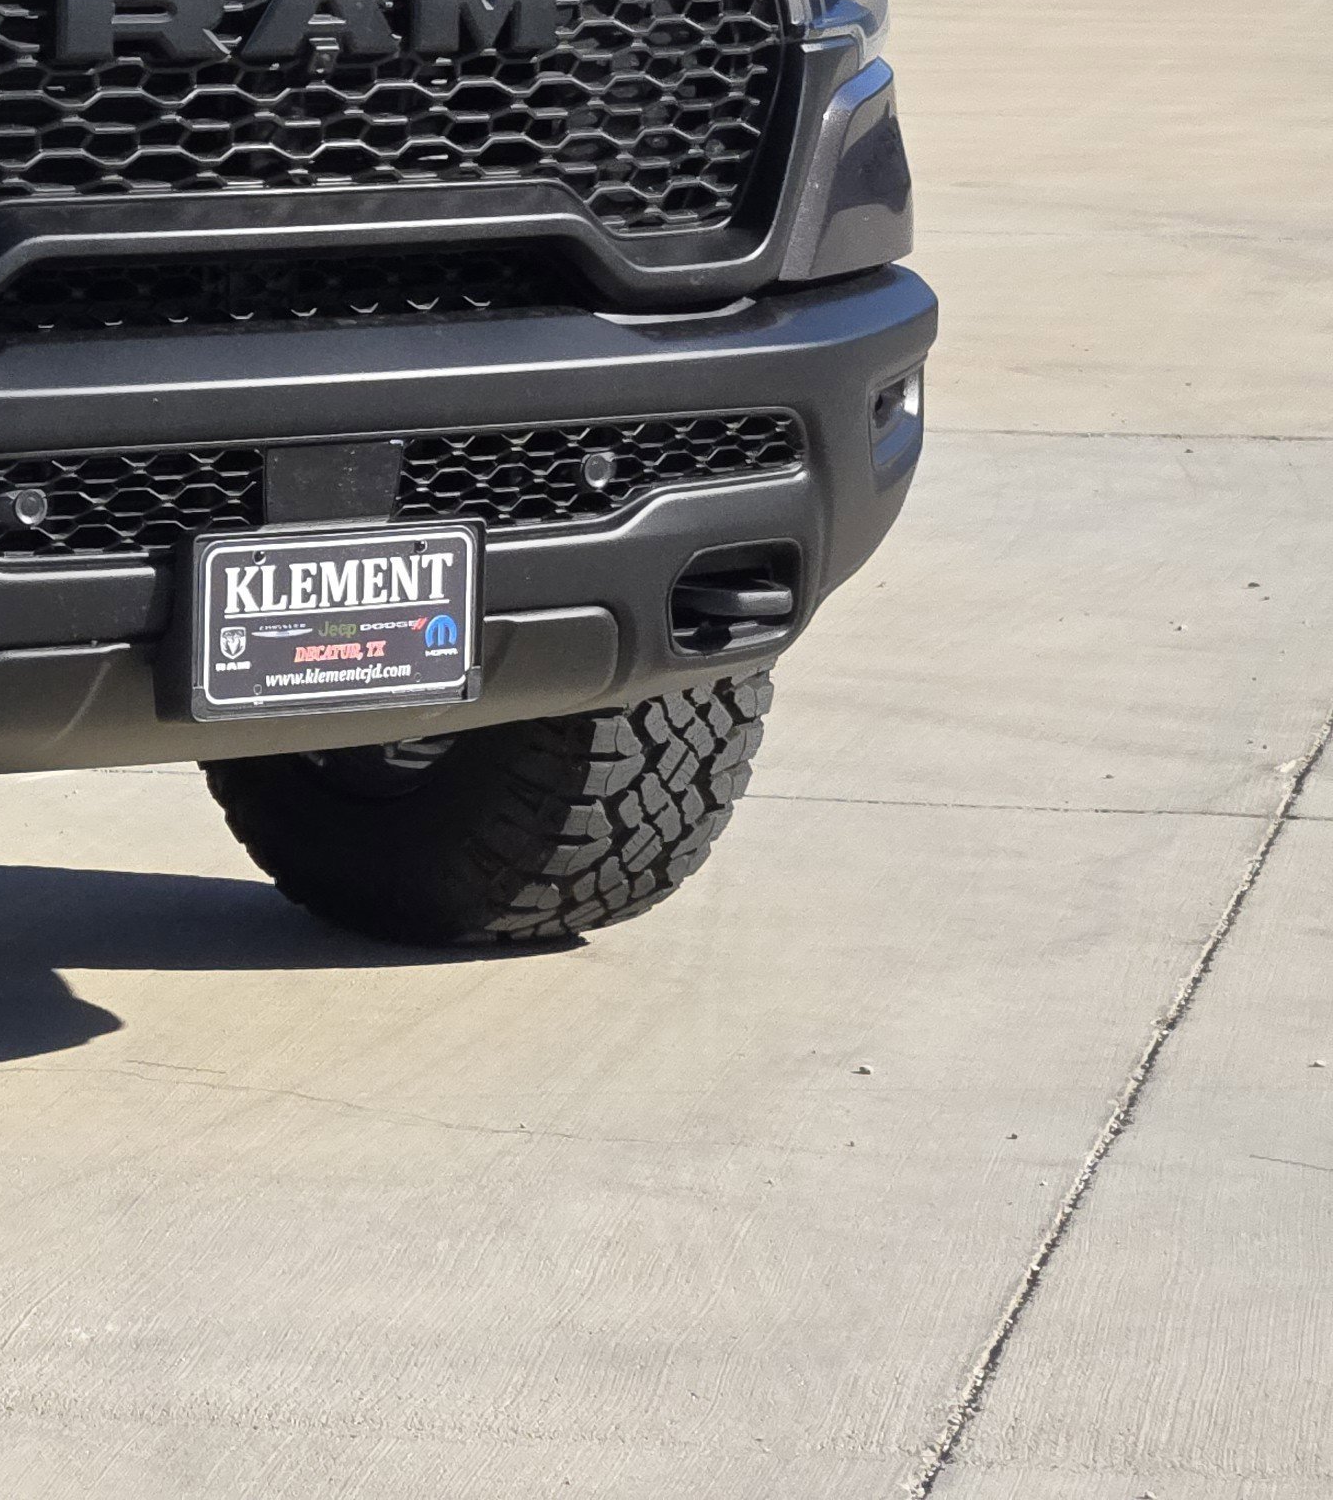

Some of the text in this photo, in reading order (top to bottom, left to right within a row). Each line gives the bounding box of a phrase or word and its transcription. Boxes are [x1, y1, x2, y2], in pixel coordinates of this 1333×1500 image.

[224, 552, 454, 614] KLEMENT
[318, 620, 357, 638] Jeep
[366, 640, 386, 658] TX
[265, 662, 412, 688] www.klementcjd.com
